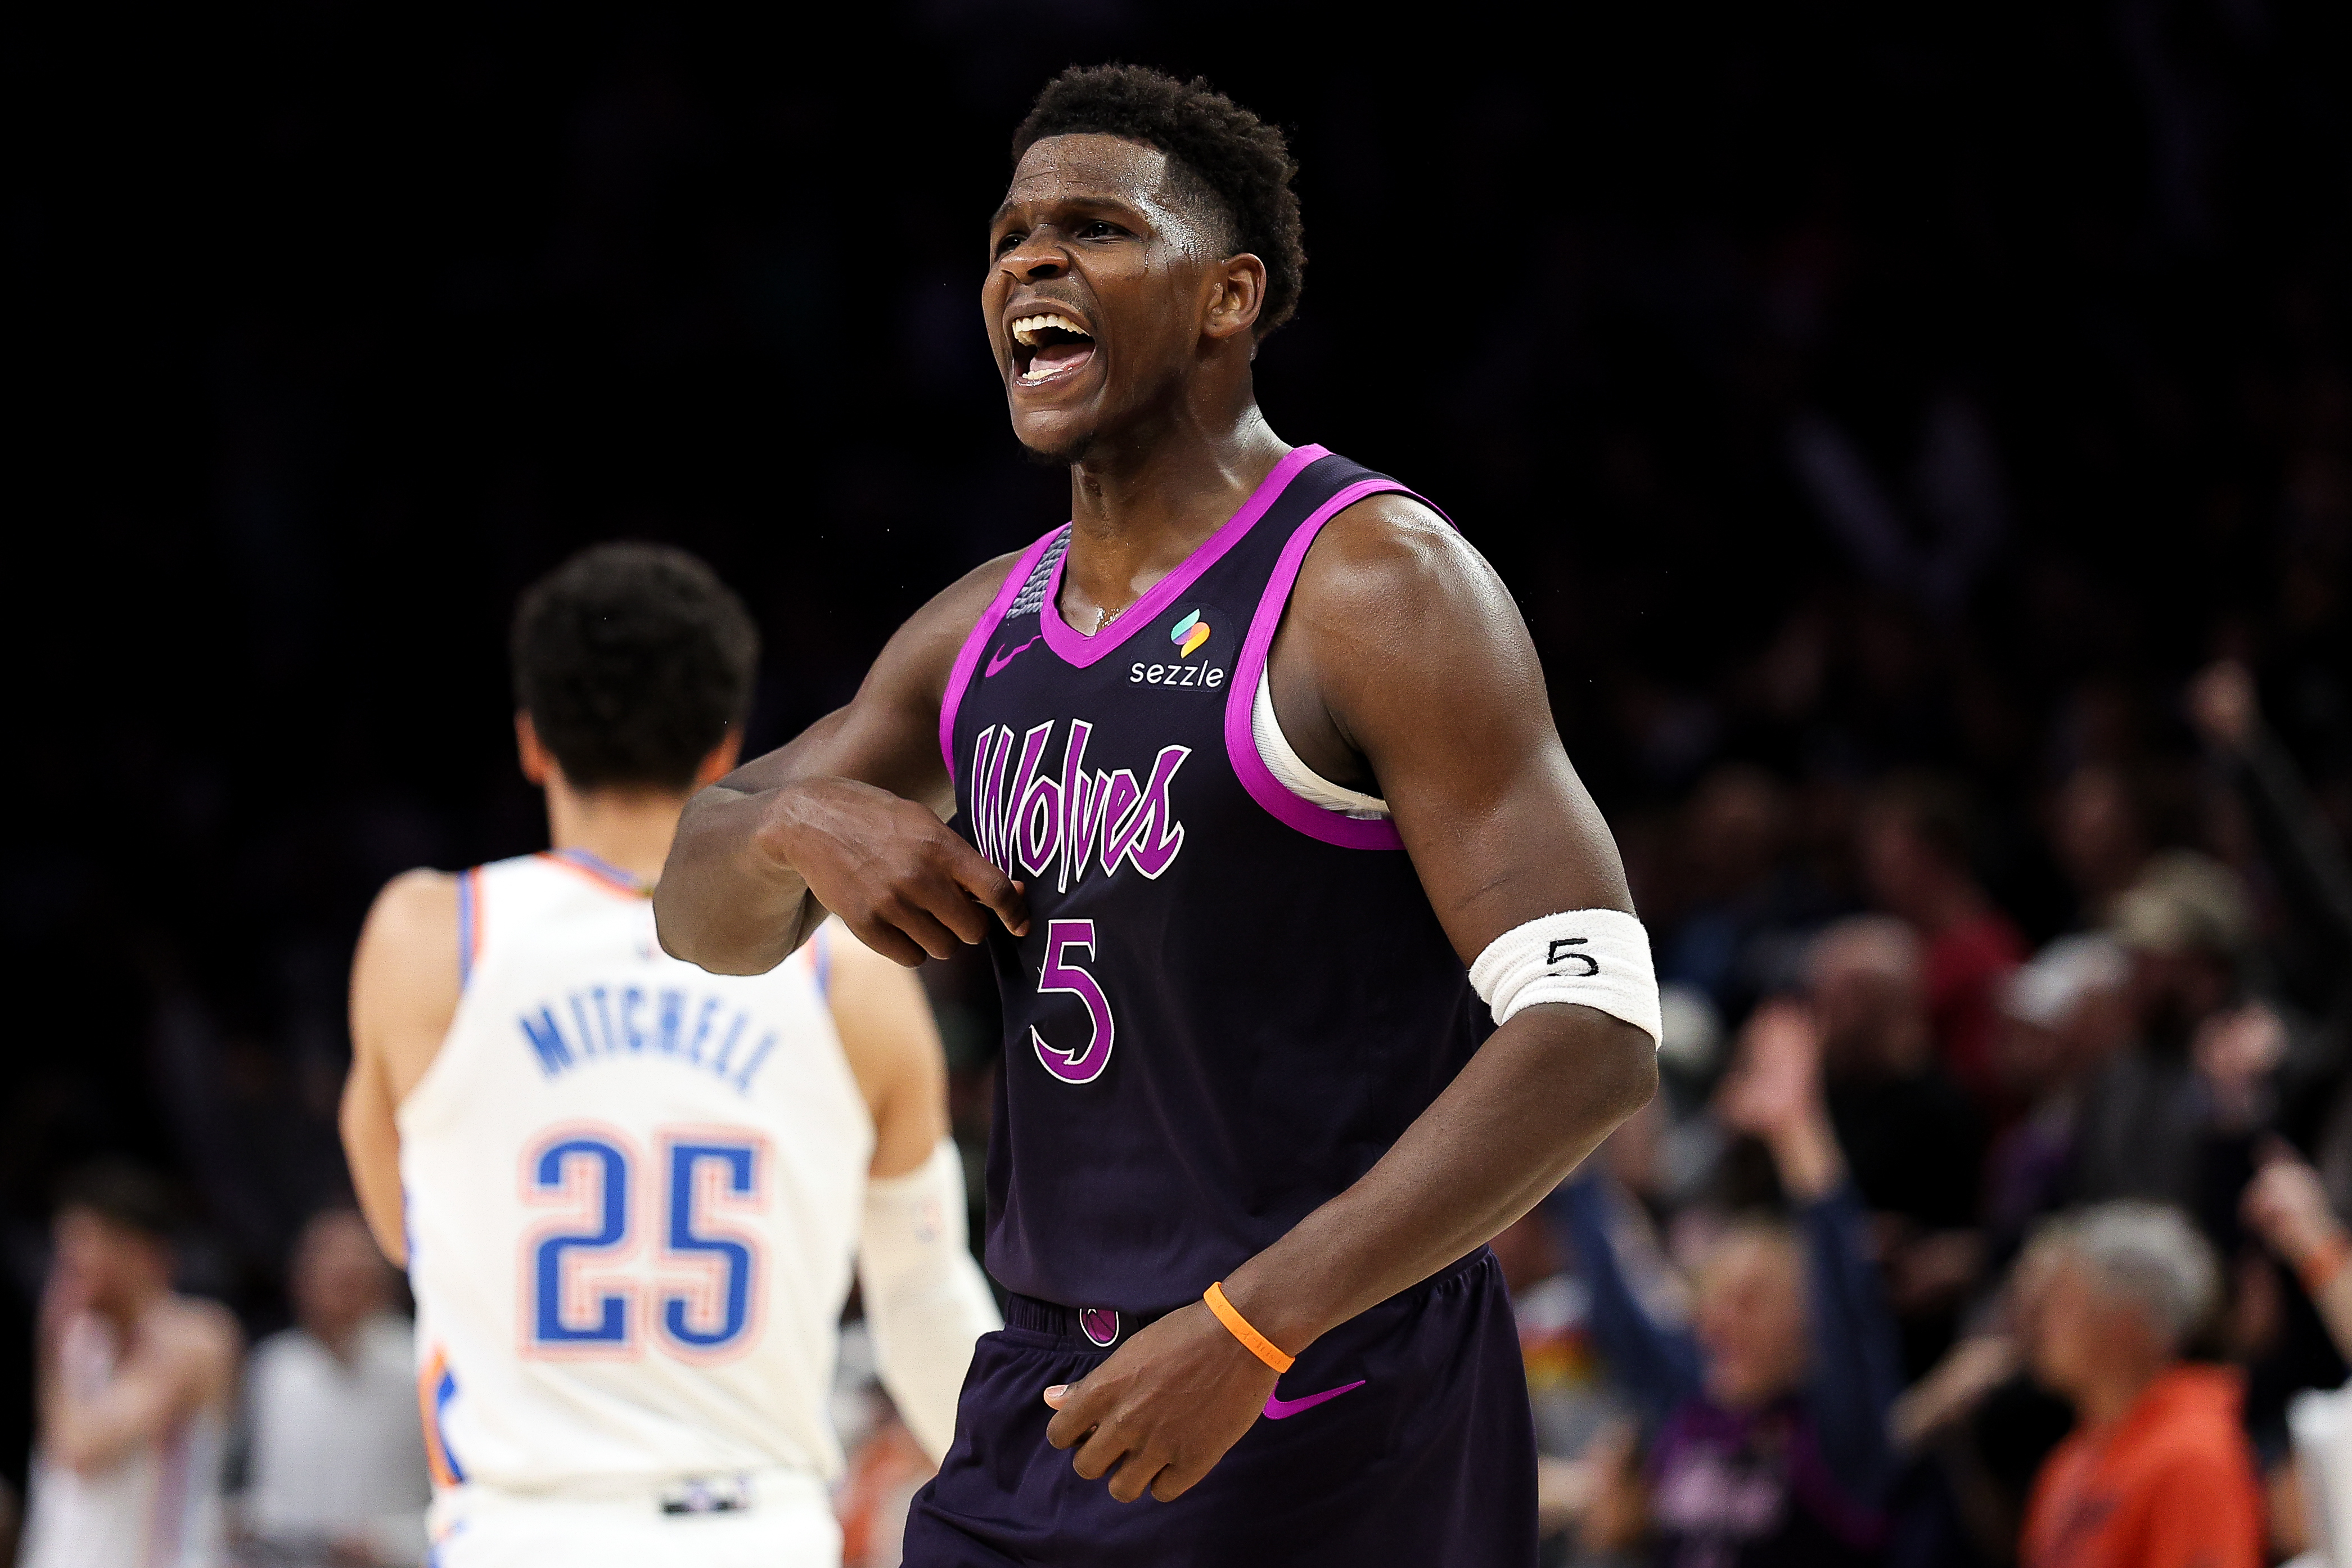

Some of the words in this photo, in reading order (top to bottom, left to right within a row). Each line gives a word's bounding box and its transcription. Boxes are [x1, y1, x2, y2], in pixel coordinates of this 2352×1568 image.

[1129, 660, 1224, 687] sezzle
[972, 718, 1192, 894] Wolves
[1030, 919, 1115, 1084] 5
[1547, 938, 1599, 977] 5
[519, 984, 780, 1096] MITCHELL
[523, 1127, 772, 1361] 25
